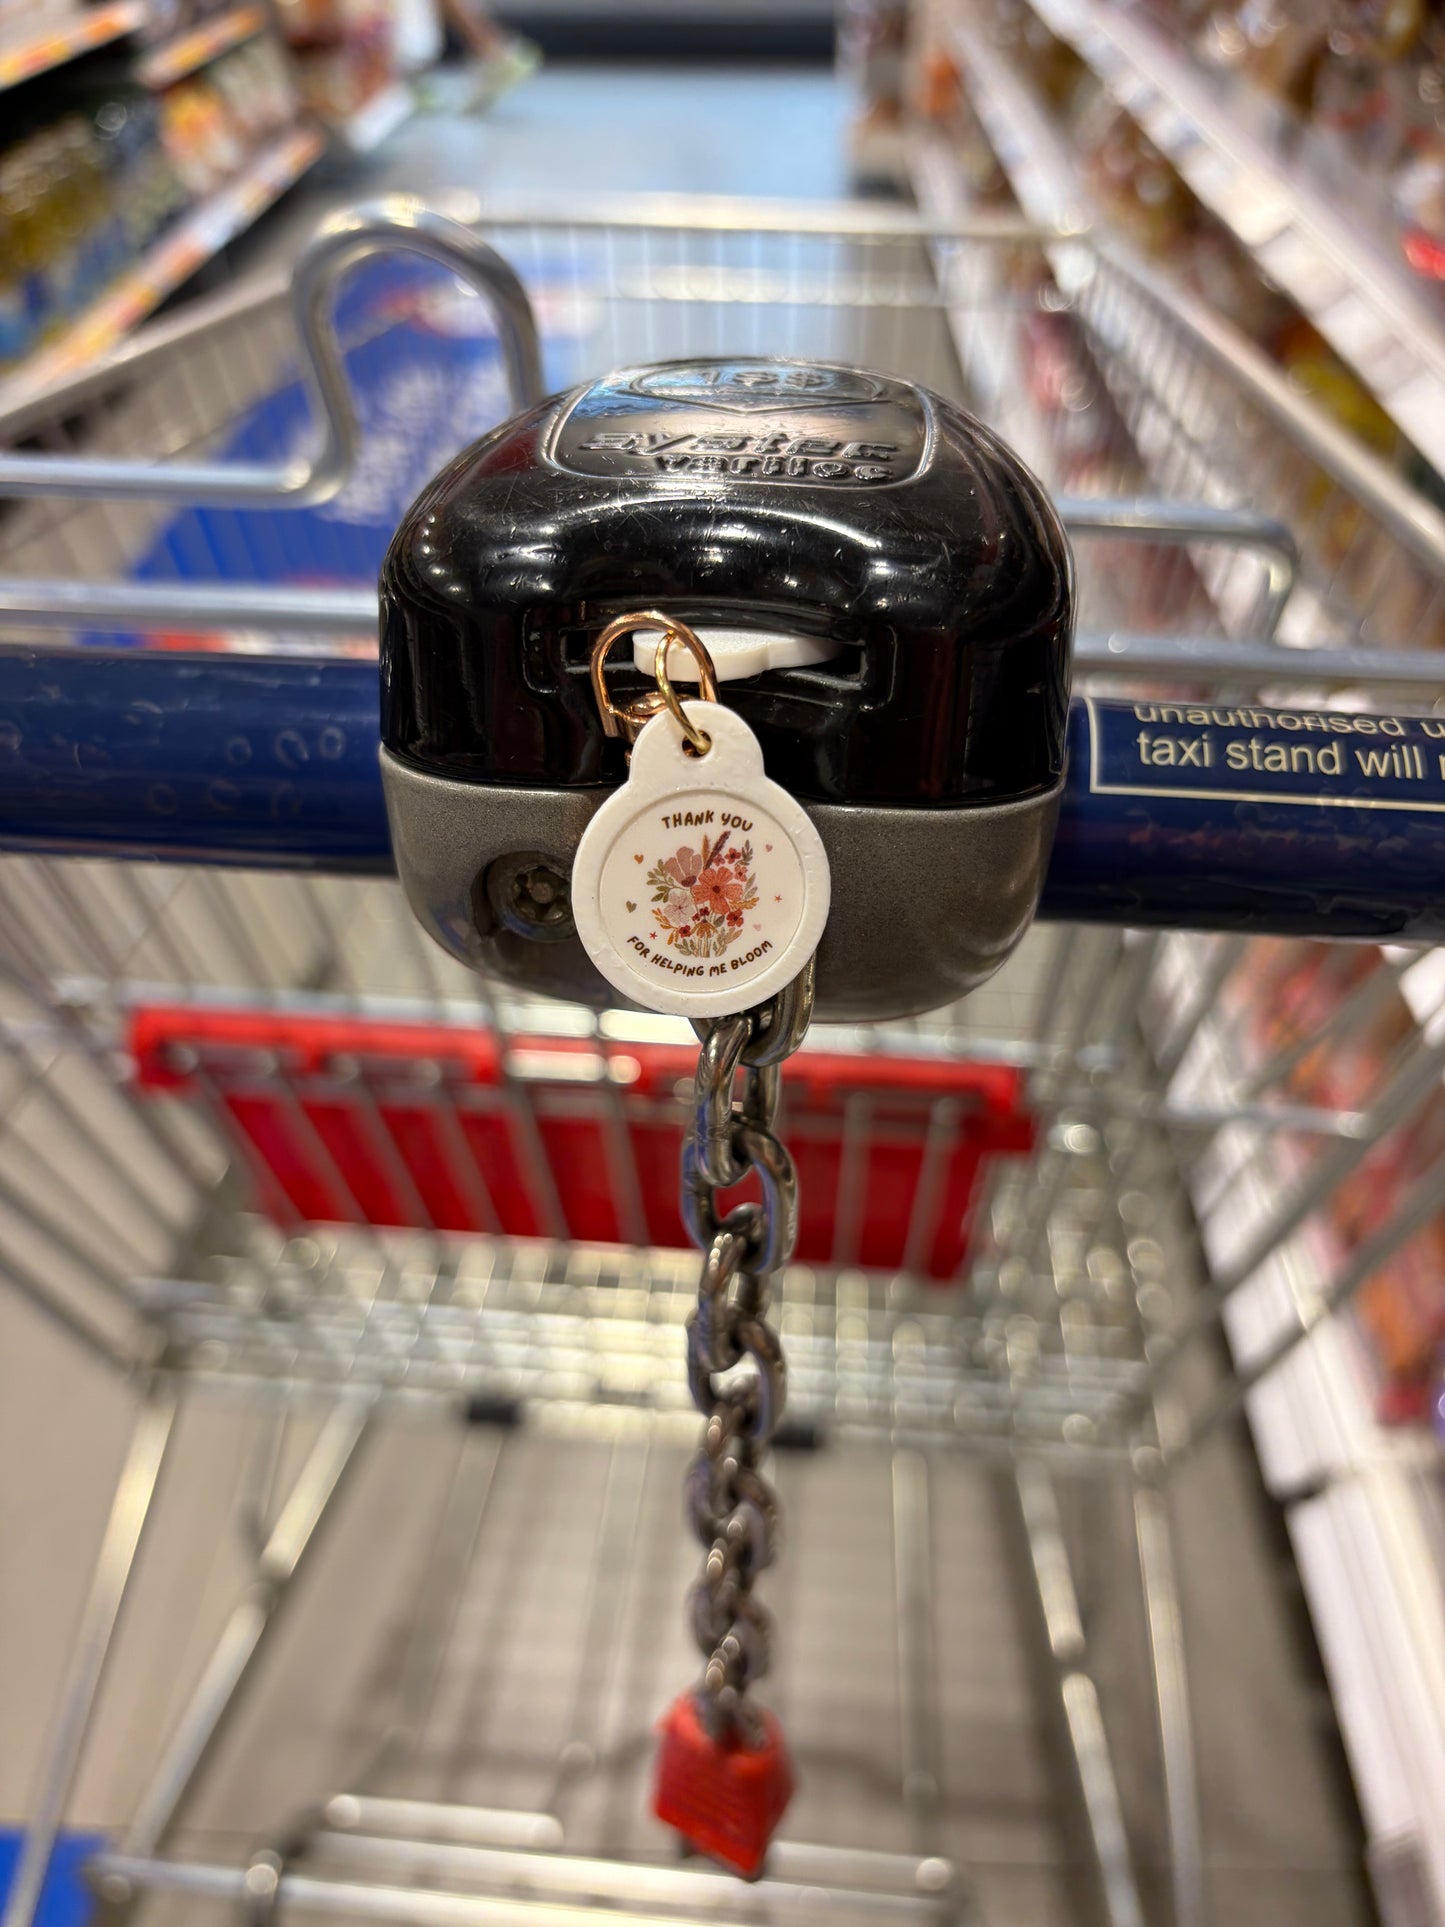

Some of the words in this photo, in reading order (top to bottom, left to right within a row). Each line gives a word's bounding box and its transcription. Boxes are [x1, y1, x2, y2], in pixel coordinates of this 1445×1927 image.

[1133, 705, 1406, 736] unauthorised
[1136, 730, 1211, 768] taxi
[1225, 738, 1342, 775] stand
[1354, 744, 1423, 779] will
[661, 810, 714, 829] THANK
[720, 812, 753, 832] YOU
[626, 934, 651, 959] FOR
[650, 952, 705, 977] HELPING
[708, 963, 728, 977] ME
[730, 939, 773, 971] BLOOM
